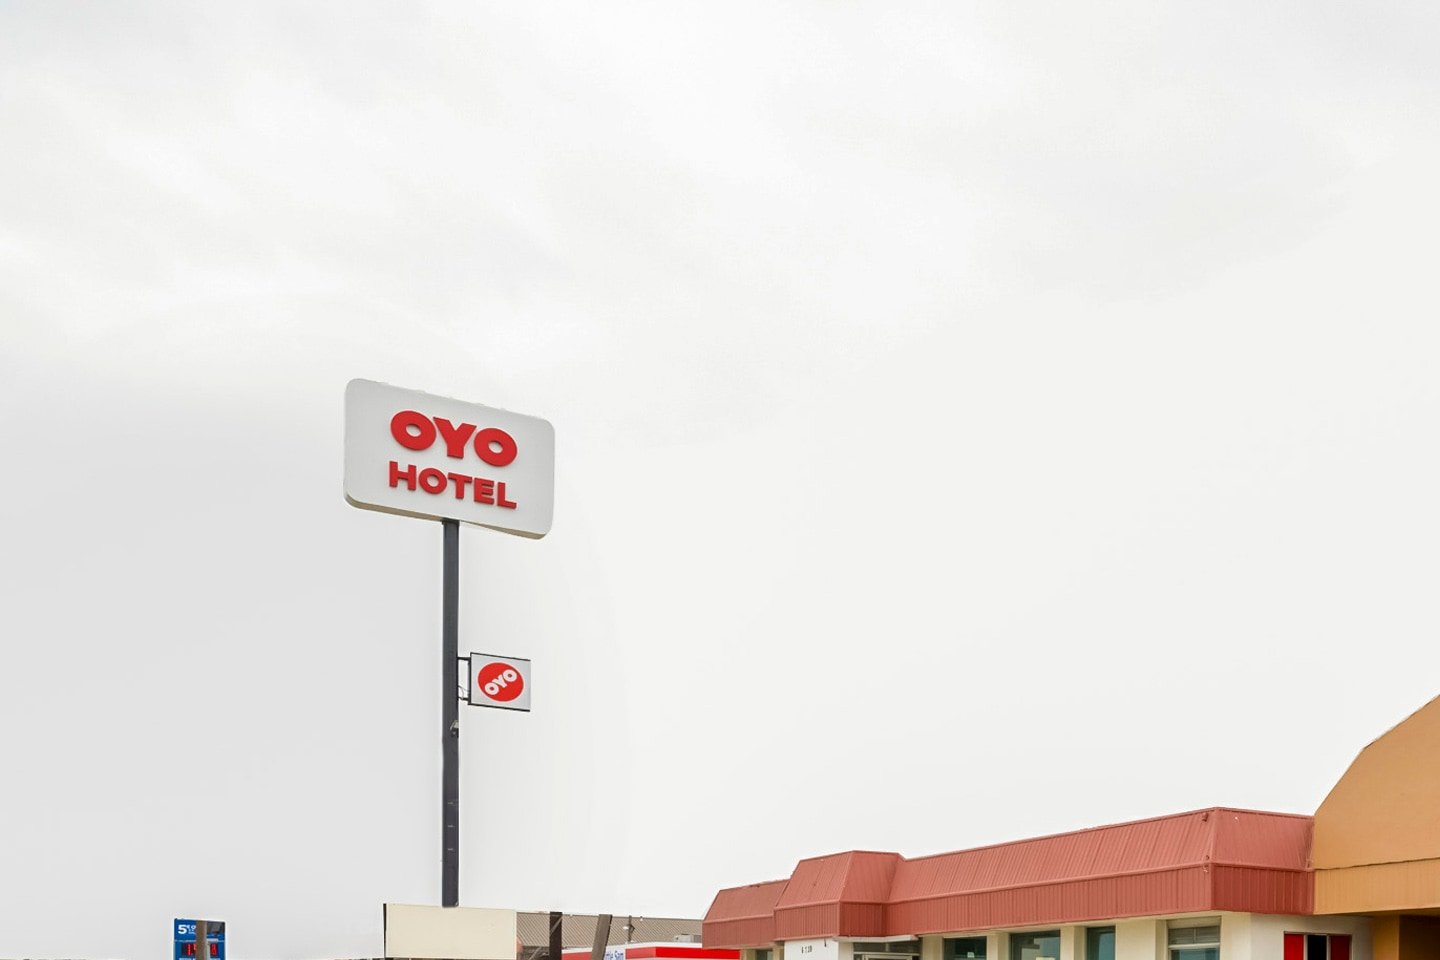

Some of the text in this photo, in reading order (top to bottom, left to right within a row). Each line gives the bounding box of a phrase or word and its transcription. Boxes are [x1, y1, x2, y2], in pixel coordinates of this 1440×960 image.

[390, 409, 518, 468] OYO
[388, 460, 518, 510] HOTEL
[483, 668, 518, 696] OYO
